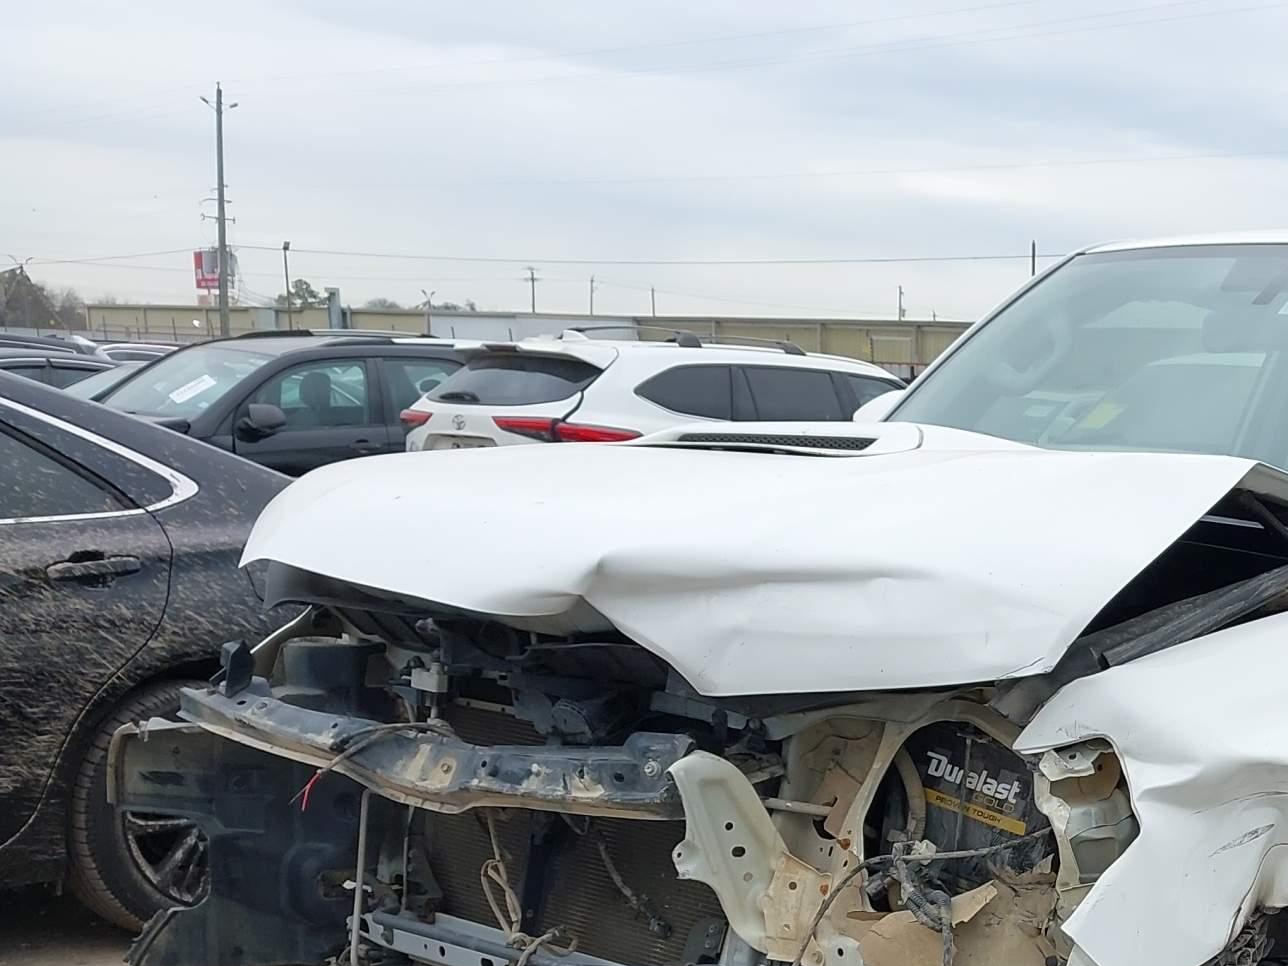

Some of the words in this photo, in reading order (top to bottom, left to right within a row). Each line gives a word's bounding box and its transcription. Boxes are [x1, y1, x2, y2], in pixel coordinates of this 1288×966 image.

[927, 751, 1022, 804] Duralast
[972, 791, 1015, 813] GOLD
[972, 808, 1002, 824] TOUGH
